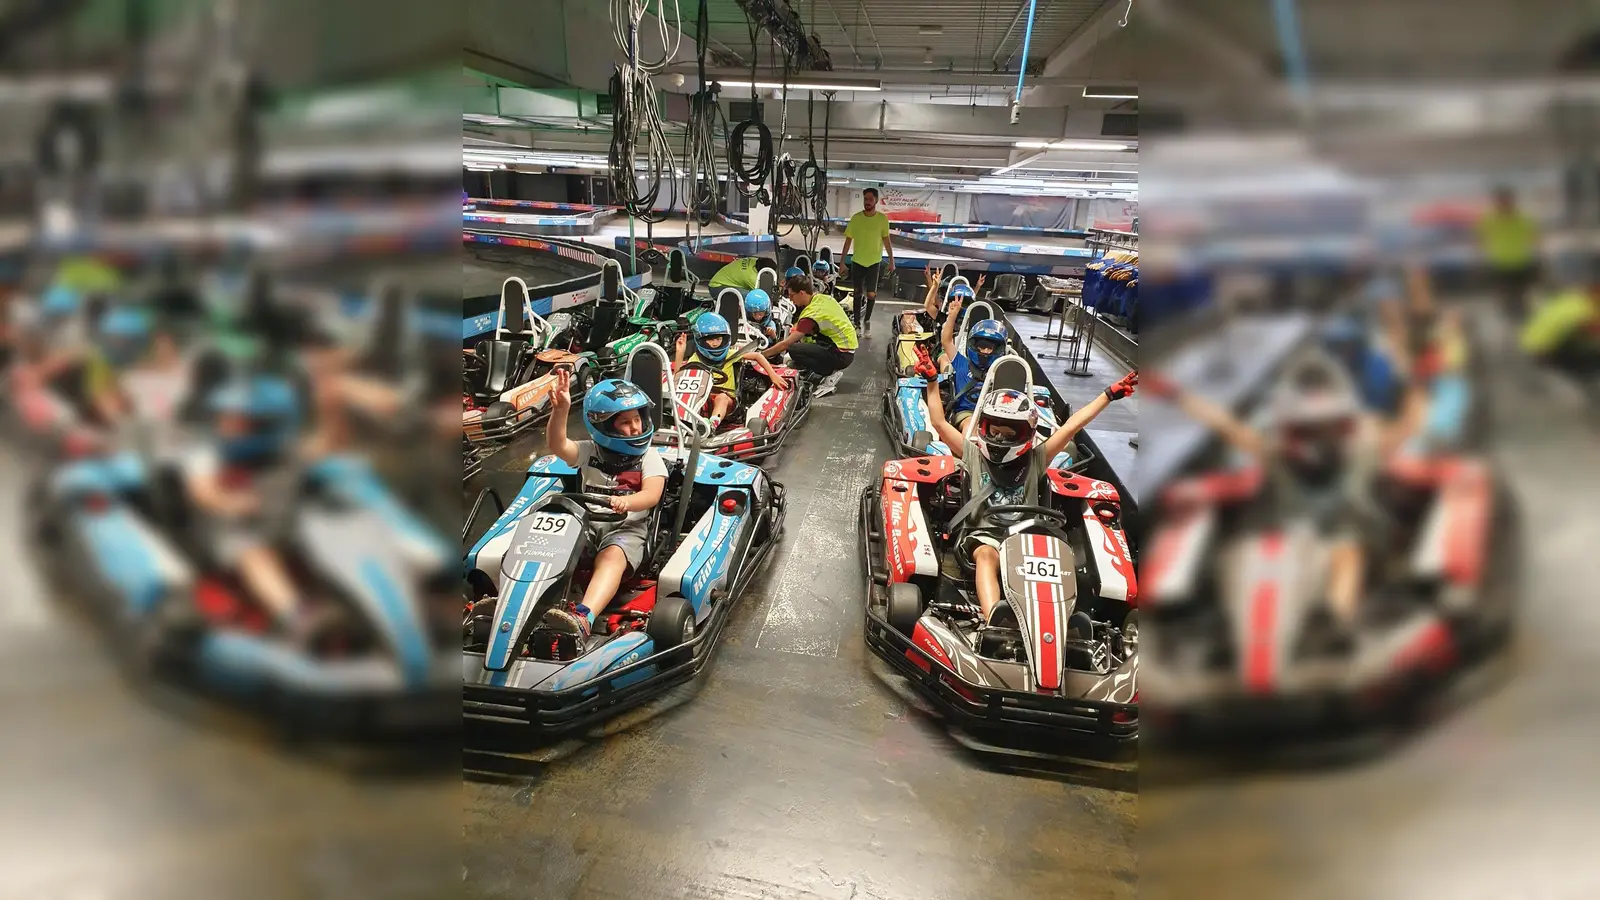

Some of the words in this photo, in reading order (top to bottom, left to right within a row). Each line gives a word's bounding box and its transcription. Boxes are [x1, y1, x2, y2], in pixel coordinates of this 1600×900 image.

[678, 379, 700, 391] 55
[891, 500, 905, 526] Kids
[532, 516, 566, 533] 159
[523, 549, 556, 558] FUNPARK
[891, 529, 904, 575] Racer
[693, 555, 717, 596] Kids
[1026, 561, 1058, 578] 161
